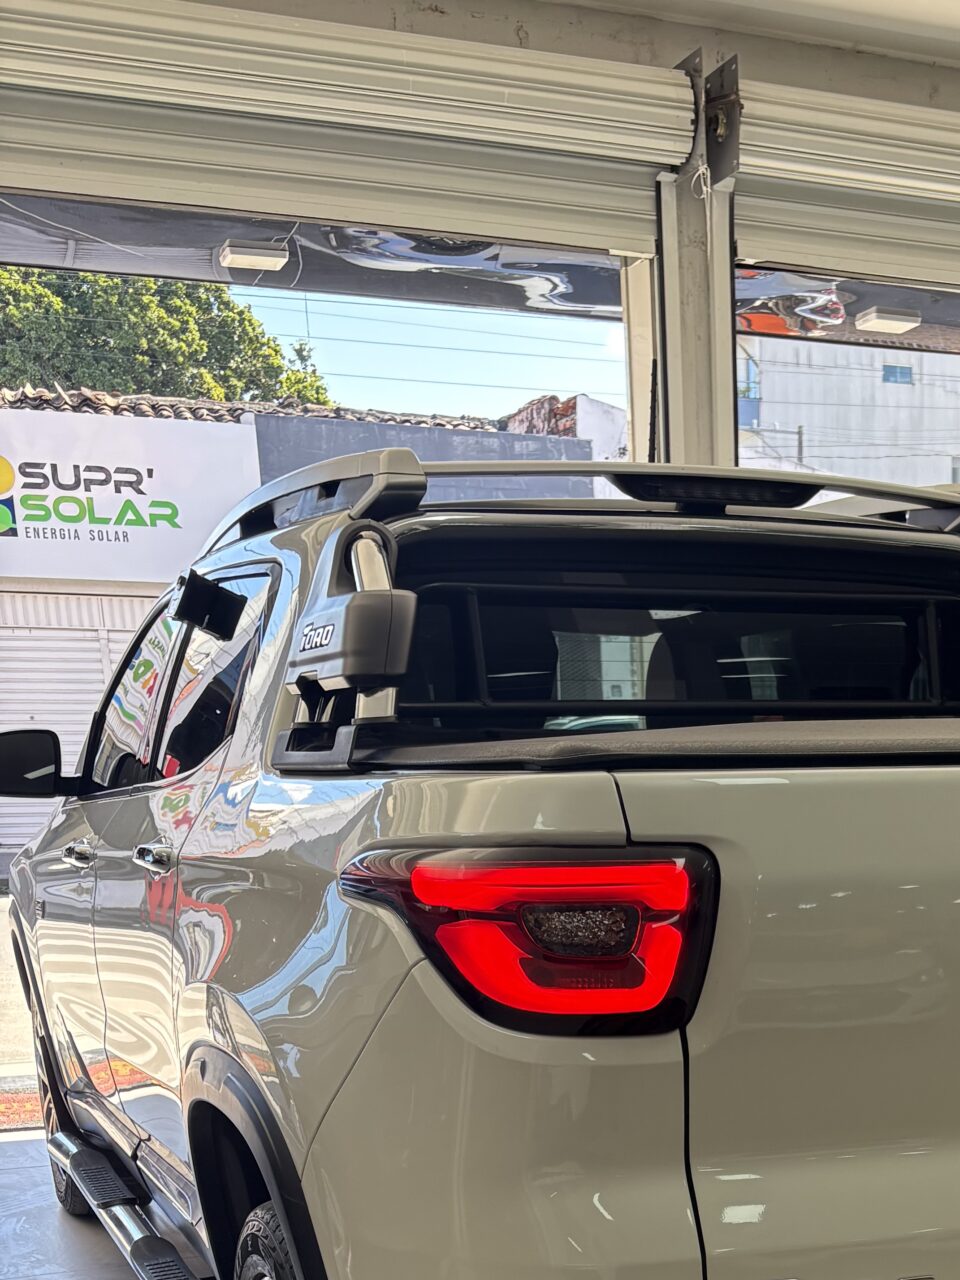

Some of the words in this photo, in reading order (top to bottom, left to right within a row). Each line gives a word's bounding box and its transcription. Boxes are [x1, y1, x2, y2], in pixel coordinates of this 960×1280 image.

[19, 494, 183, 529] SOLAR
[24, 526, 81, 541] ENERGIA
[89, 529, 130, 543] SOLAR
[300, 621, 335, 652] TORO
